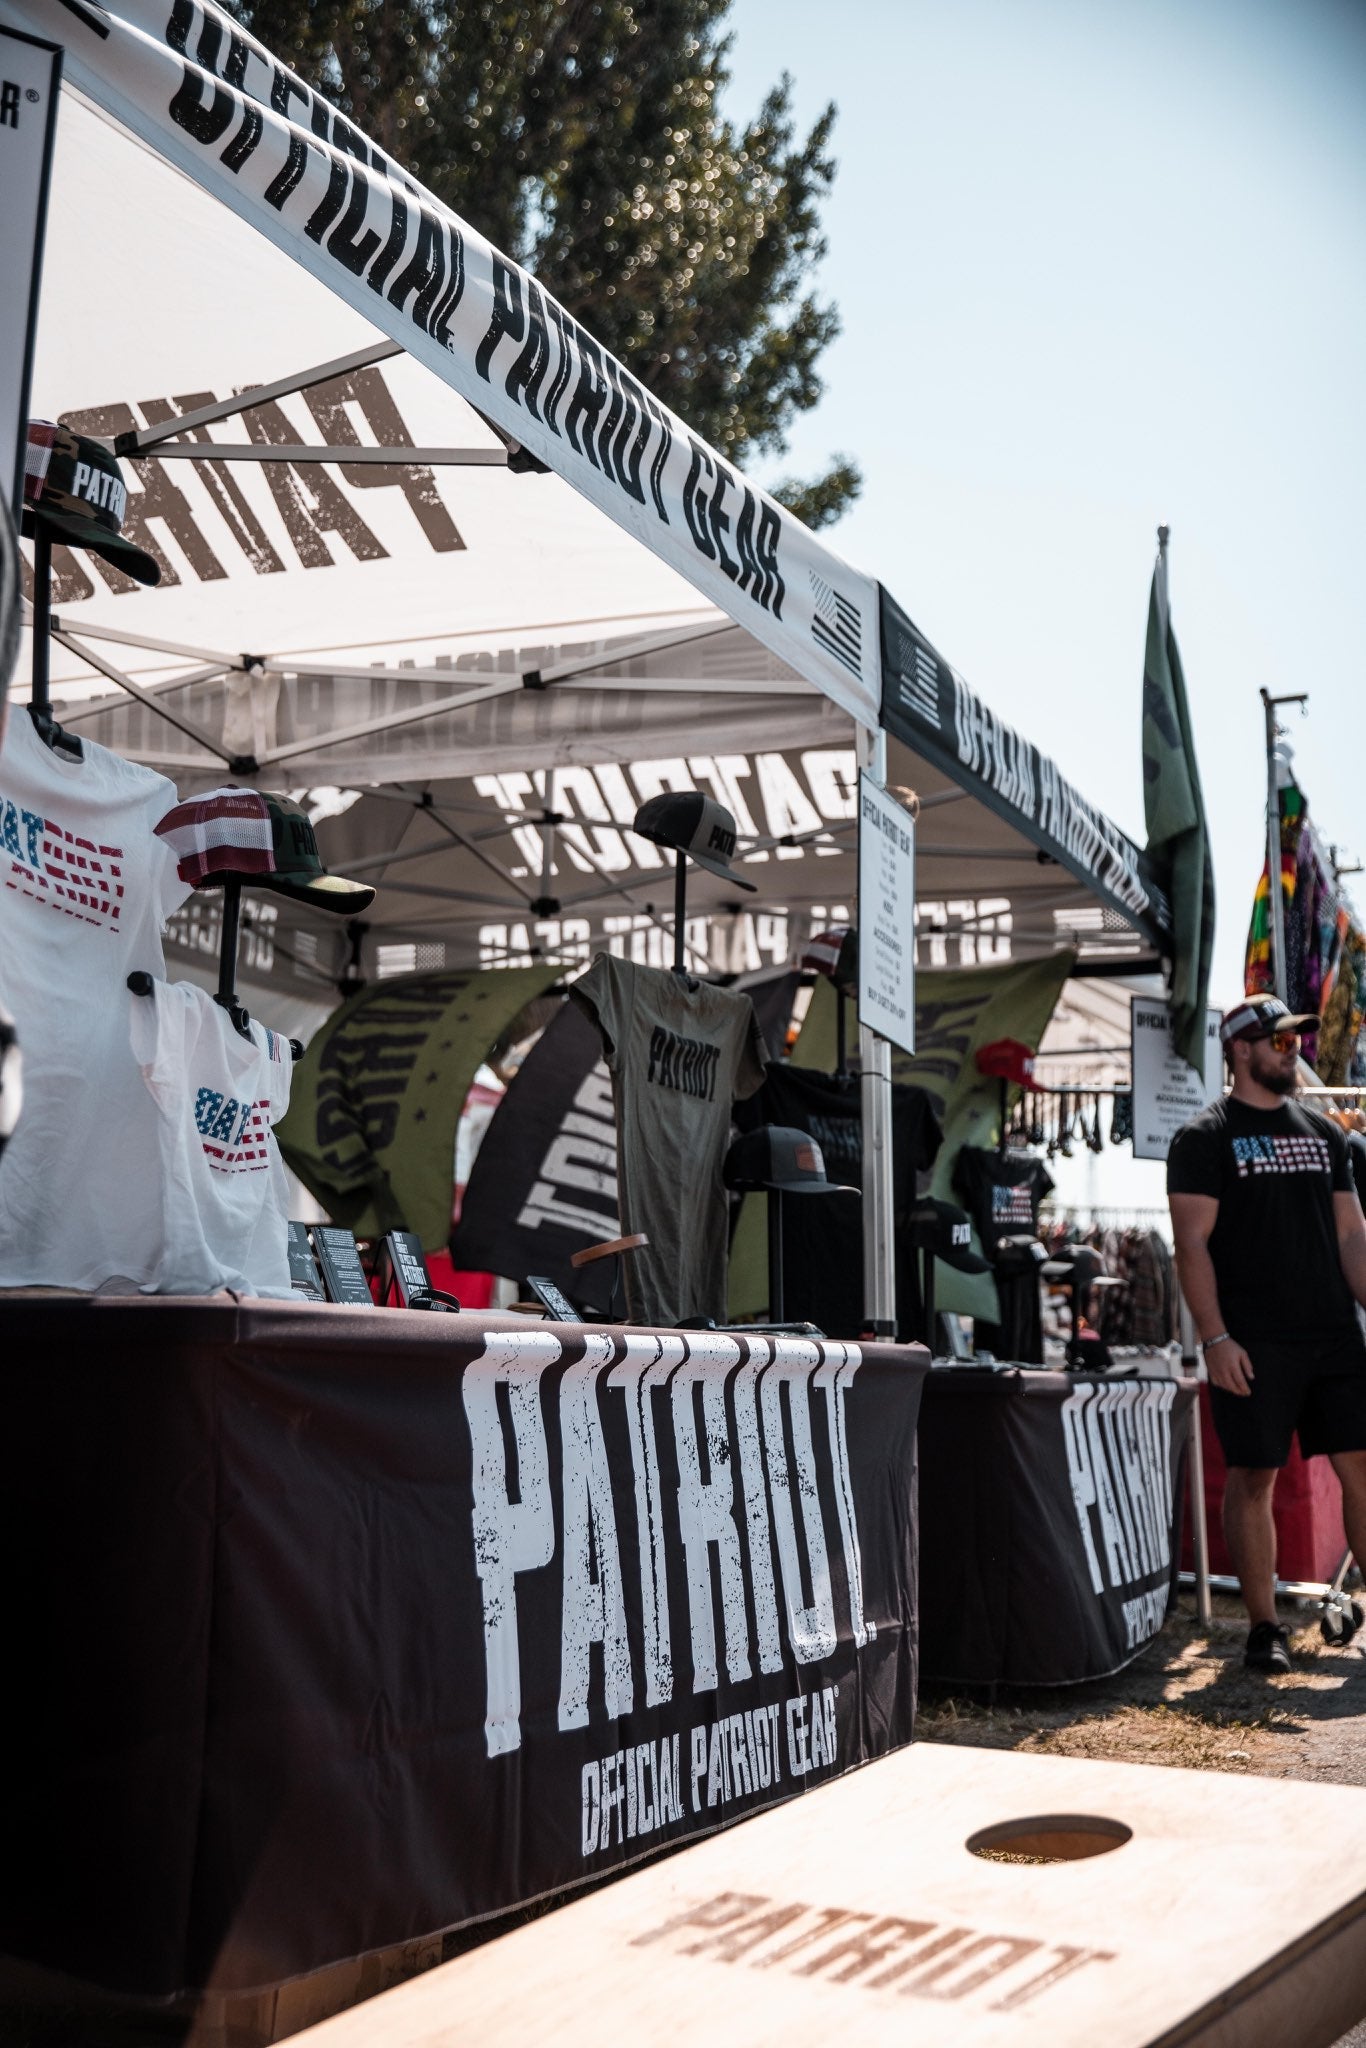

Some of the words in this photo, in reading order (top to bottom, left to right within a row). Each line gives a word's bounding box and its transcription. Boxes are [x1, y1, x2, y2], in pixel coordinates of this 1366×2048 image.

[475, 250, 672, 525] PATRIOT
[683, 434, 785, 621] GEAR
[648, 1025, 721, 1102] PATRIOT
[462, 1331, 872, 1758] PATRIOT
[581, 1733, 685, 1858] OFFICIAL
[690, 1703, 781, 1813] PATRIOT
[627, 1891, 1118, 2012] PATRIOT
